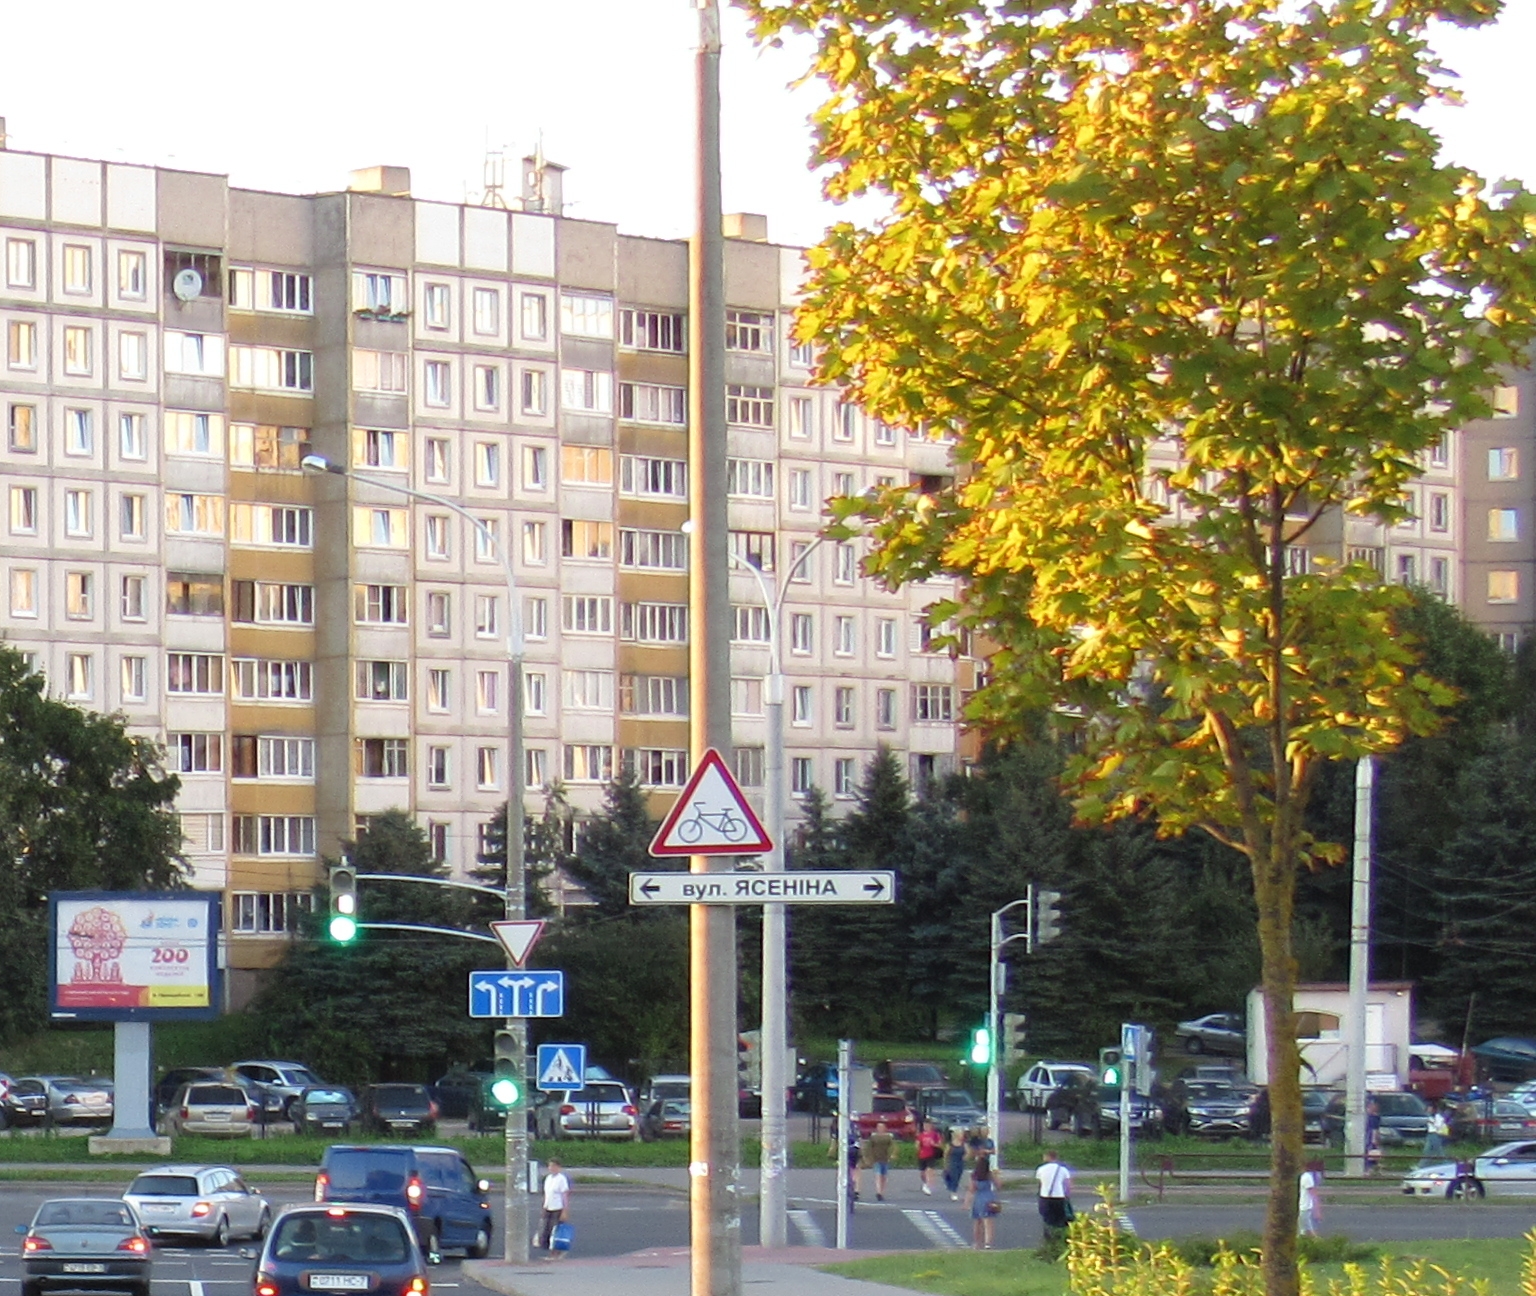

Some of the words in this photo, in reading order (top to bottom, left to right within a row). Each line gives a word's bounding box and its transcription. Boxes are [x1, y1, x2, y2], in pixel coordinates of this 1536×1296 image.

[683, 883, 727, 899] вул.
[735, 879, 837, 897] ЯСЕНІНА
[151, 947, 189, 963] 200
